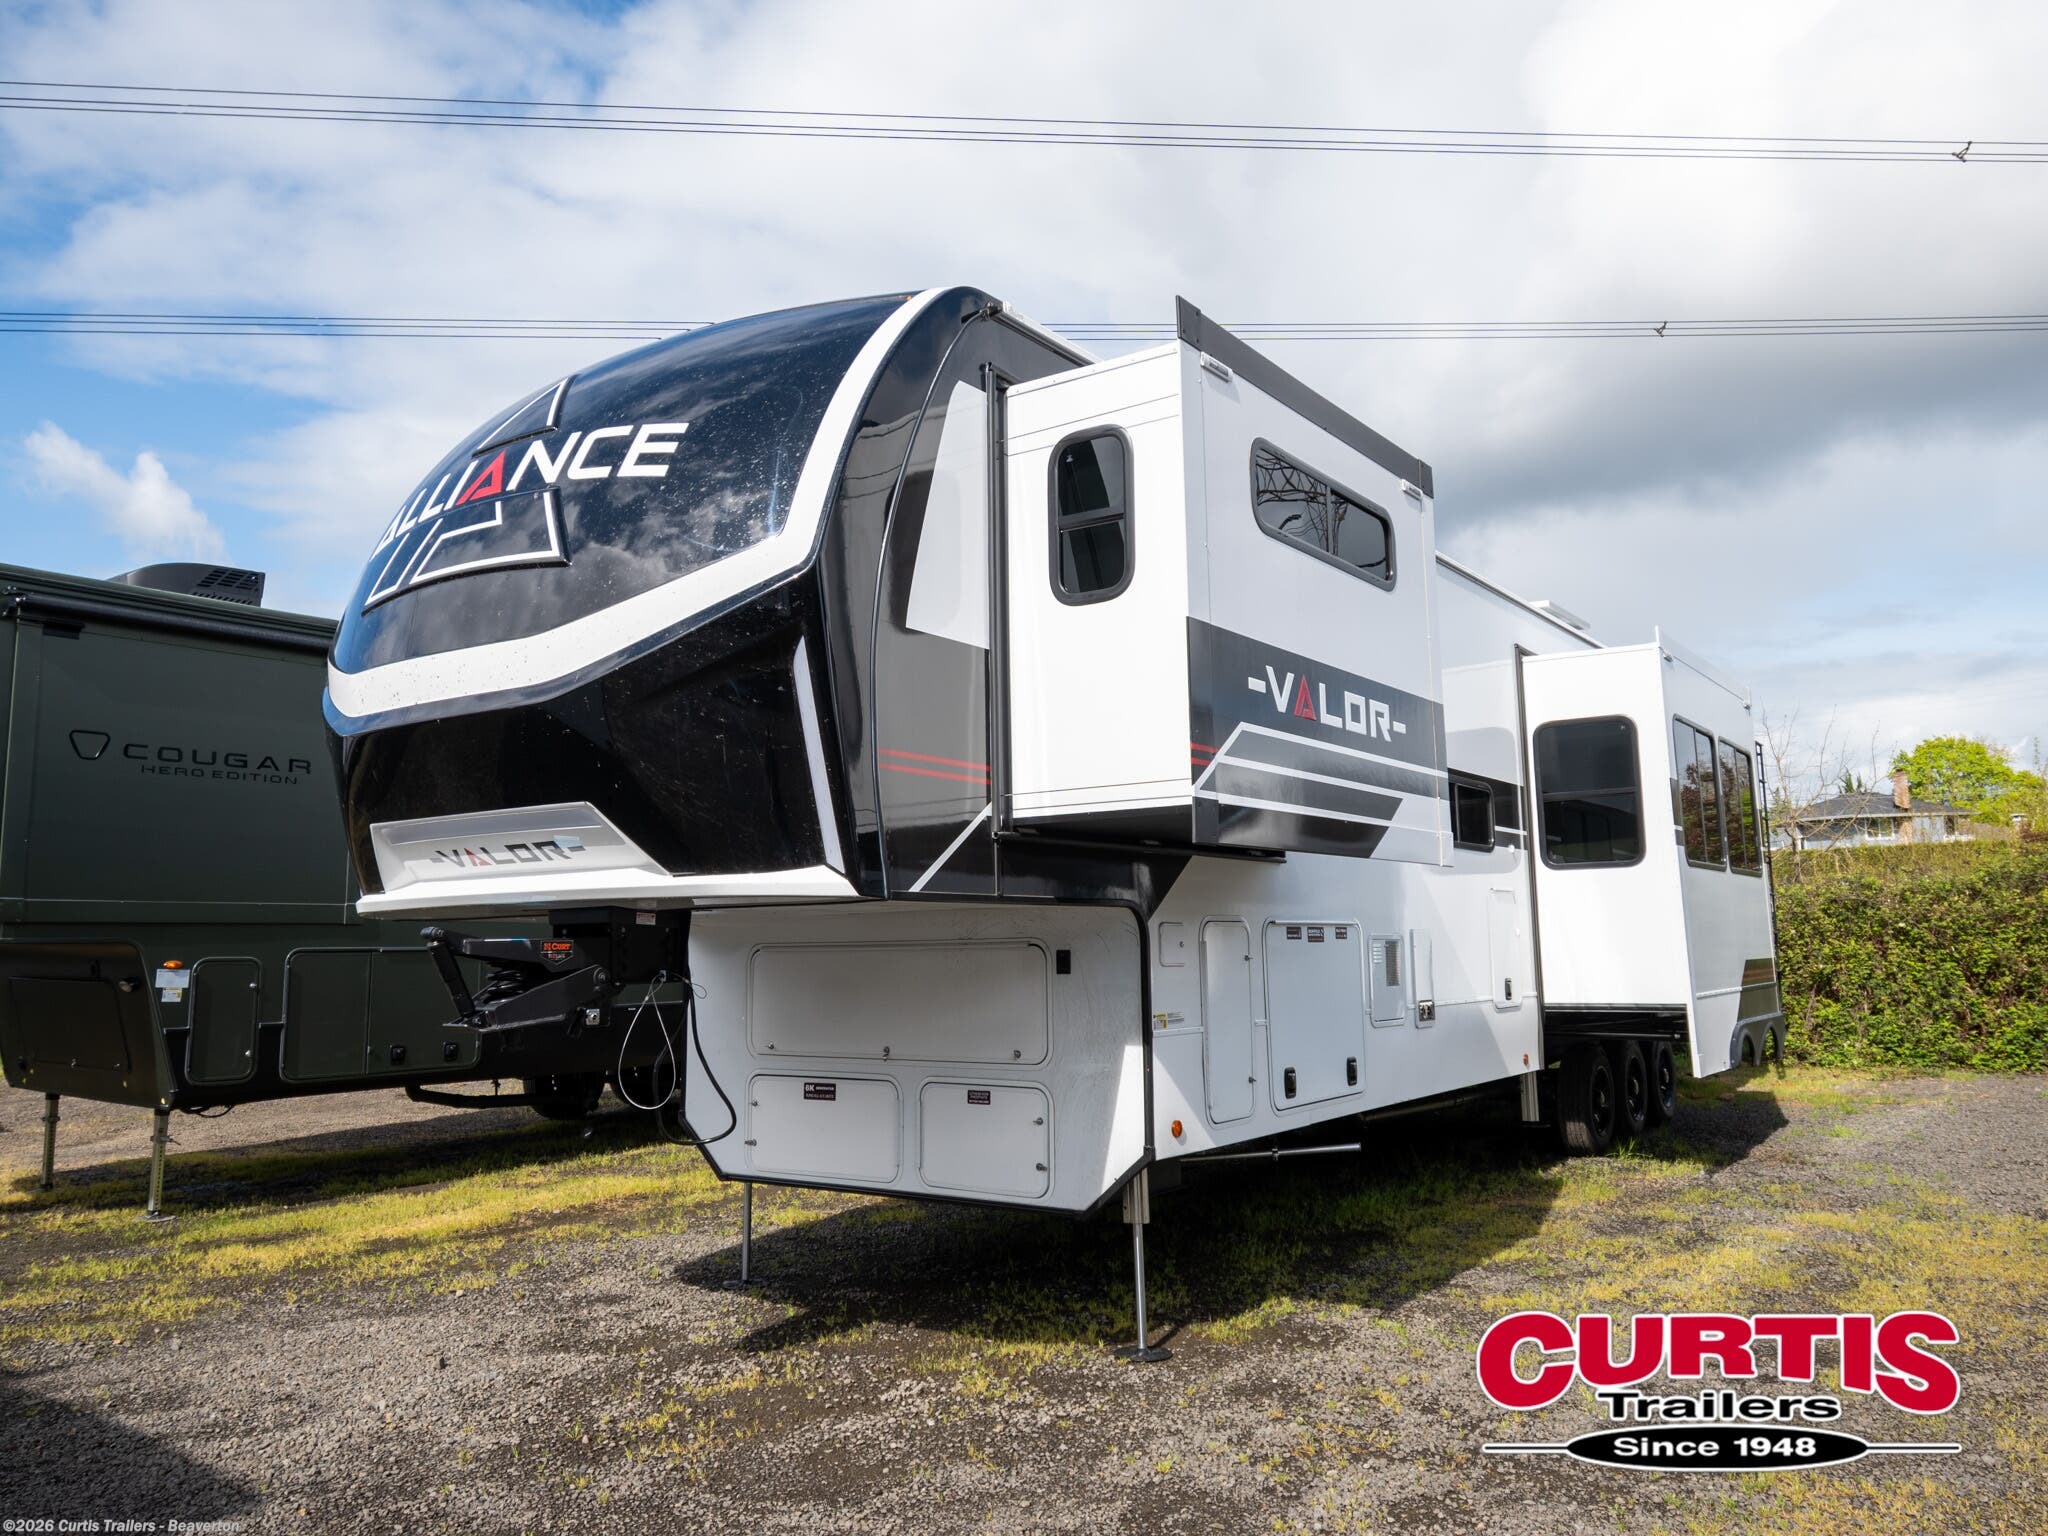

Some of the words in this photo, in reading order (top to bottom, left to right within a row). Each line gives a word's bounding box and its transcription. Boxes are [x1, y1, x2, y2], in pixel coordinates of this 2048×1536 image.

[369, 423, 690, 561] ALLIANCE
[123, 743, 313, 775] COUGAR
[141, 764, 204, 778] HERO
[212, 769, 298, 785] EDITION
